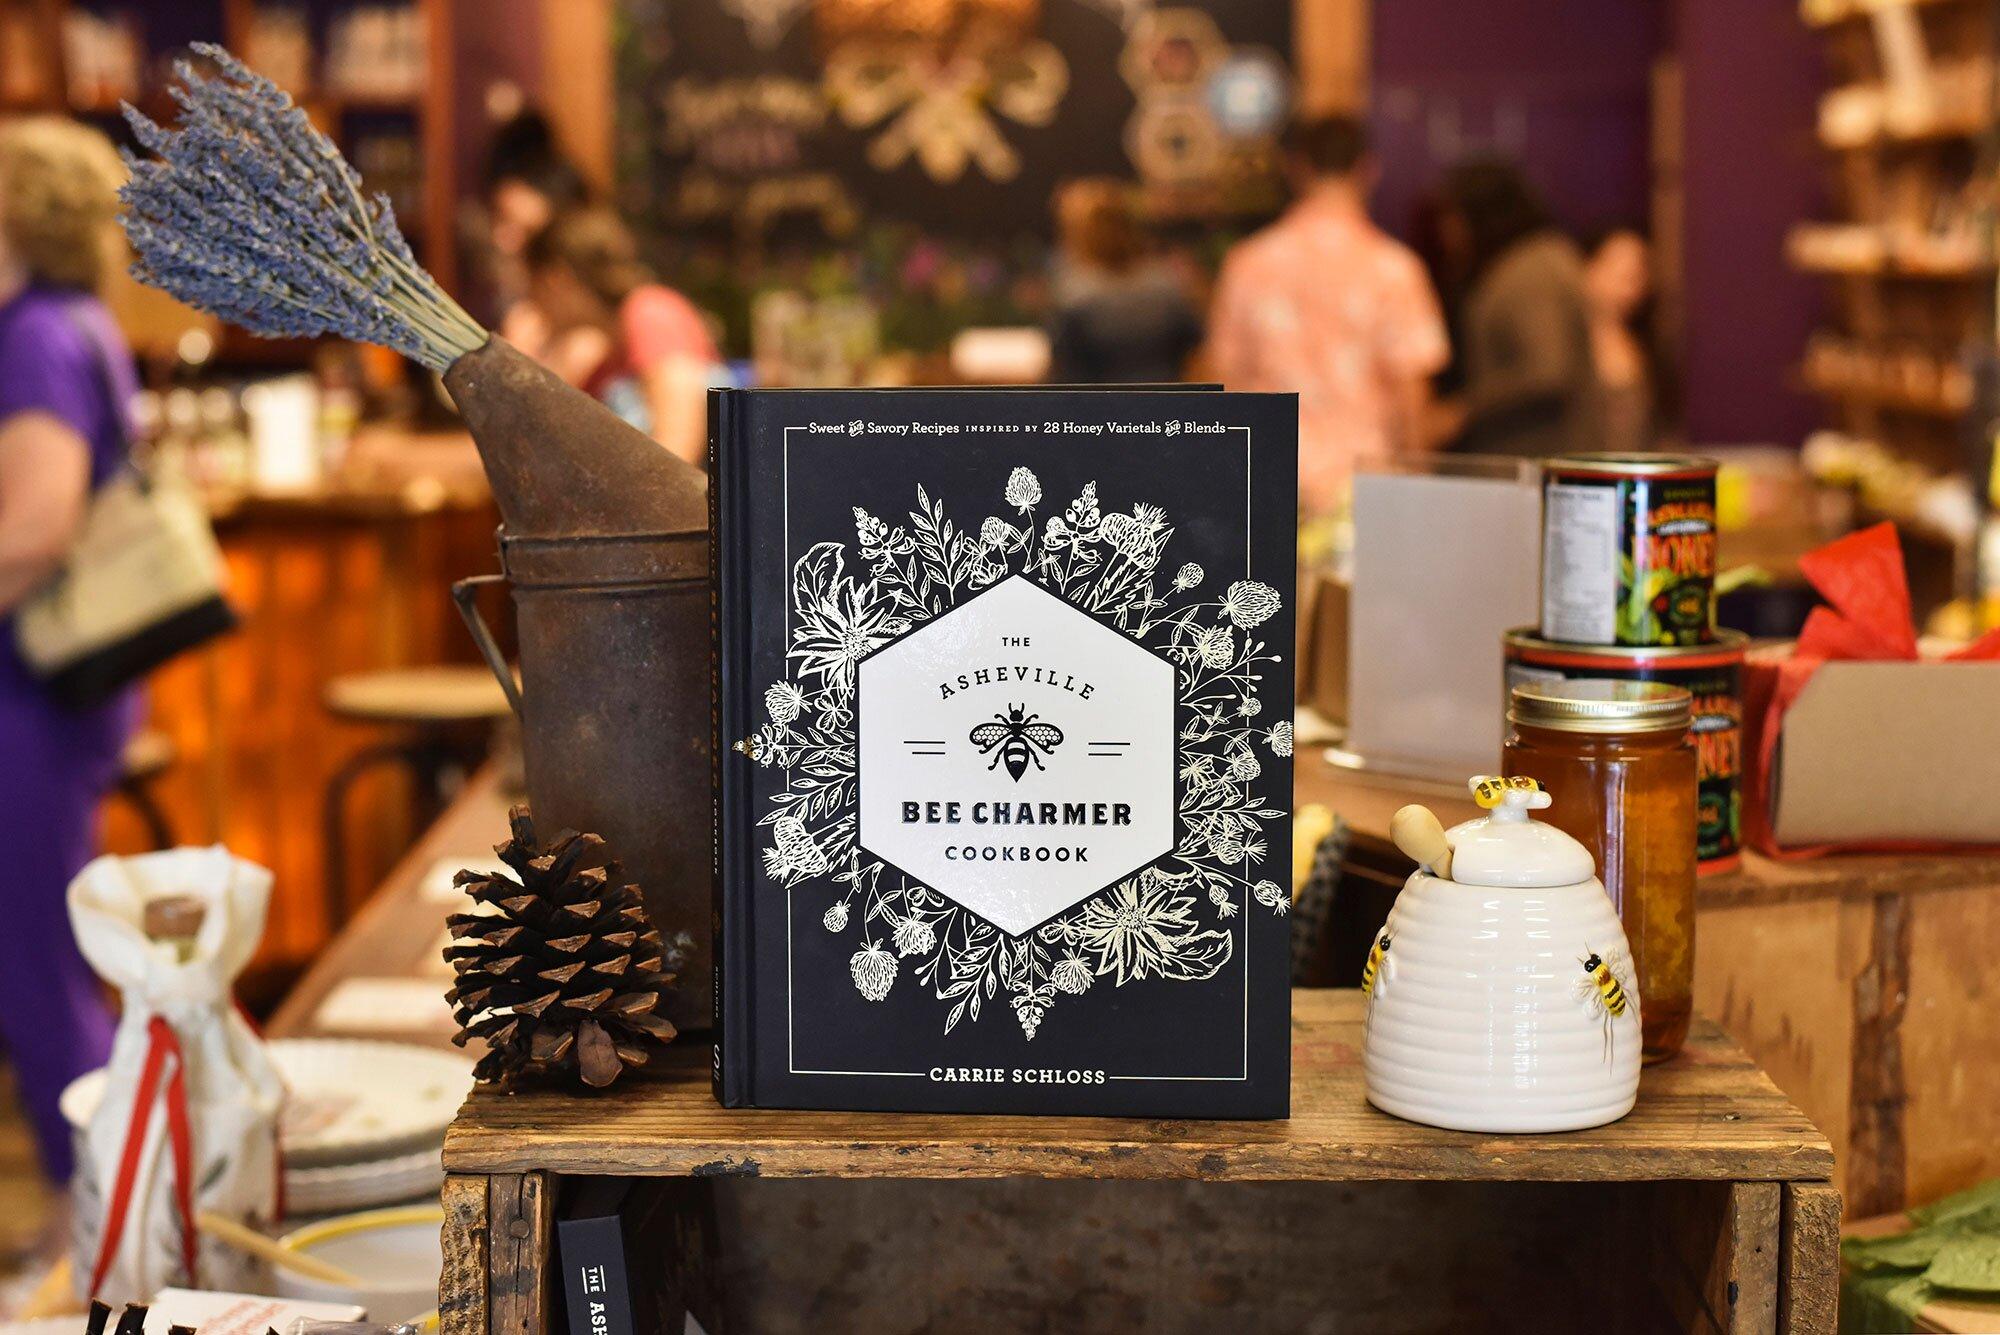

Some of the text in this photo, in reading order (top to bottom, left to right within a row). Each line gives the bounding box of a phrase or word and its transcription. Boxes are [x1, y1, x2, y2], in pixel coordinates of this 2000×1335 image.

[809, 421, 846, 434] Sweet
[867, 422, 909, 436] Savory
[911, 422, 960, 436] Recipes
[965, 425, 1020, 433] INSPIRED
[1024, 425, 1038, 433] BY
[1043, 421, 1060, 434] 28
[1062, 421, 1104, 436] Honey
[1106, 420, 1162, 434] Varietals
[1183, 421, 1226, 434] Blends
[1002, 637, 1031, 648] THE
[939, 666, 1096, 701] ASHEVILLE
[901, 801, 1132, 827] BEE CHARMER
[945, 845, 1089, 863] COOKBOOK
[929, 1067, 1106, 1086] CARRIE SCHLOSS
[588, 1267, 600, 1293] THE
